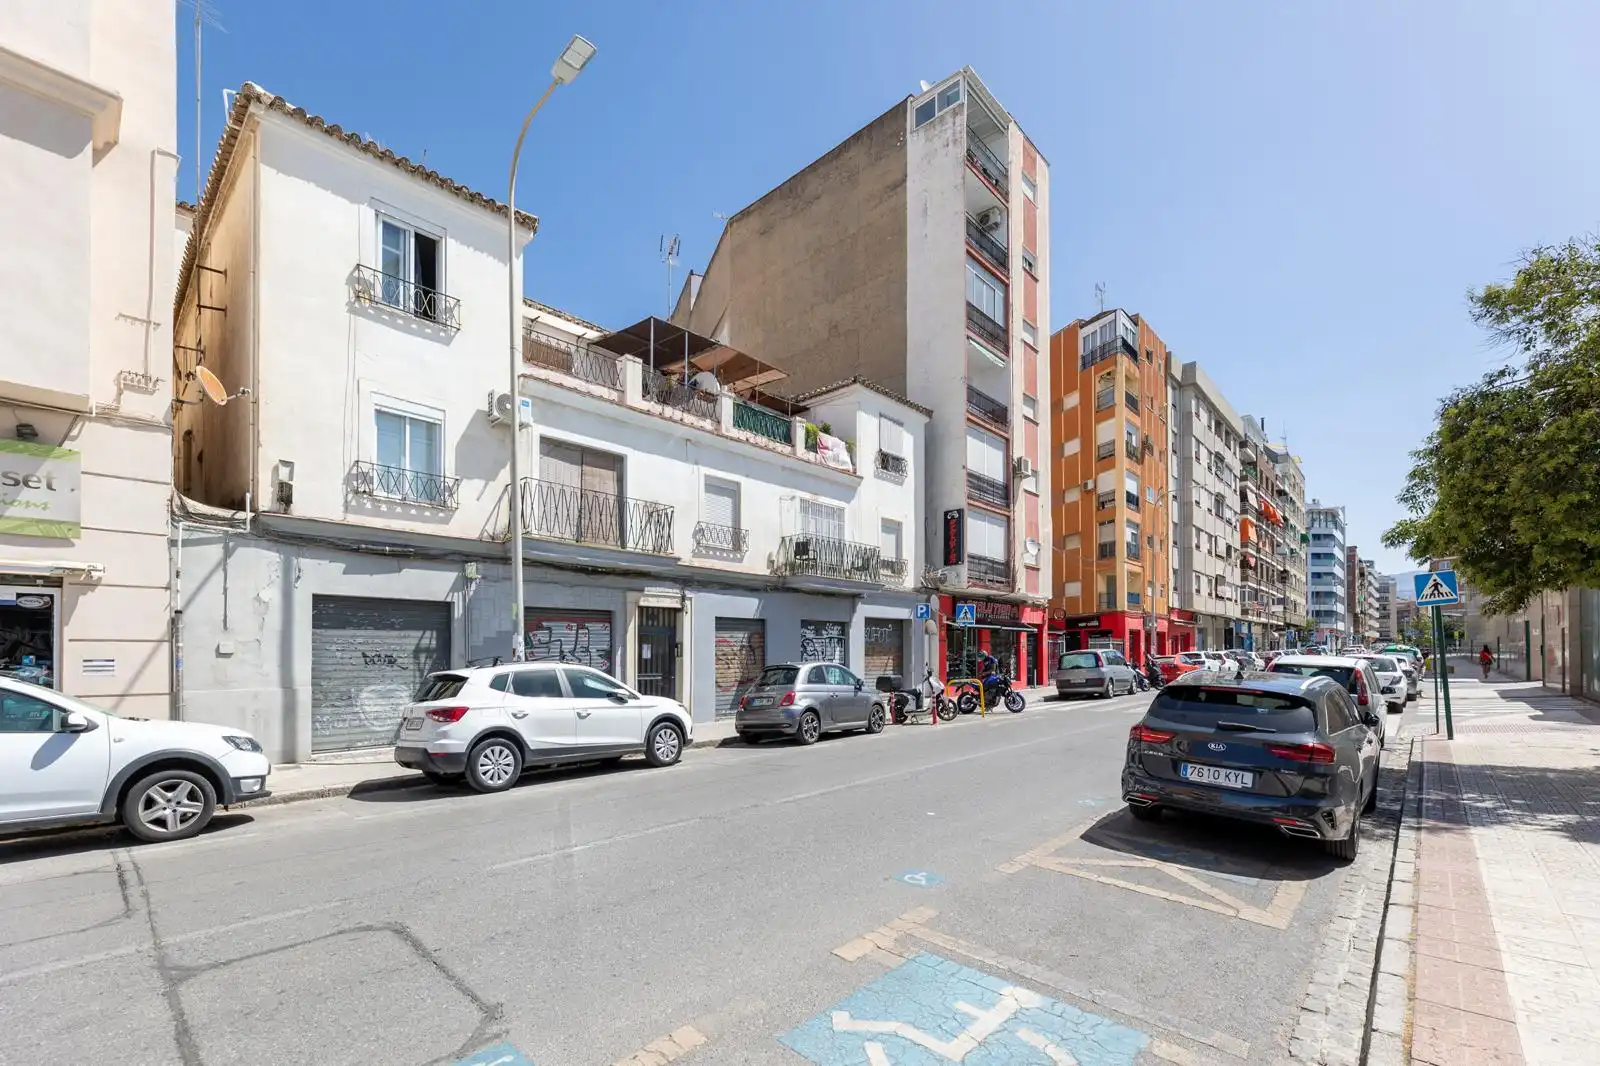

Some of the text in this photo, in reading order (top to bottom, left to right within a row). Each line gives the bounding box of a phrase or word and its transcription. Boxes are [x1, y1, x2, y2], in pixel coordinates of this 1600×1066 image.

[917, 604, 927, 618] P
[1189, 766, 1249, 785] 7610 KYL
